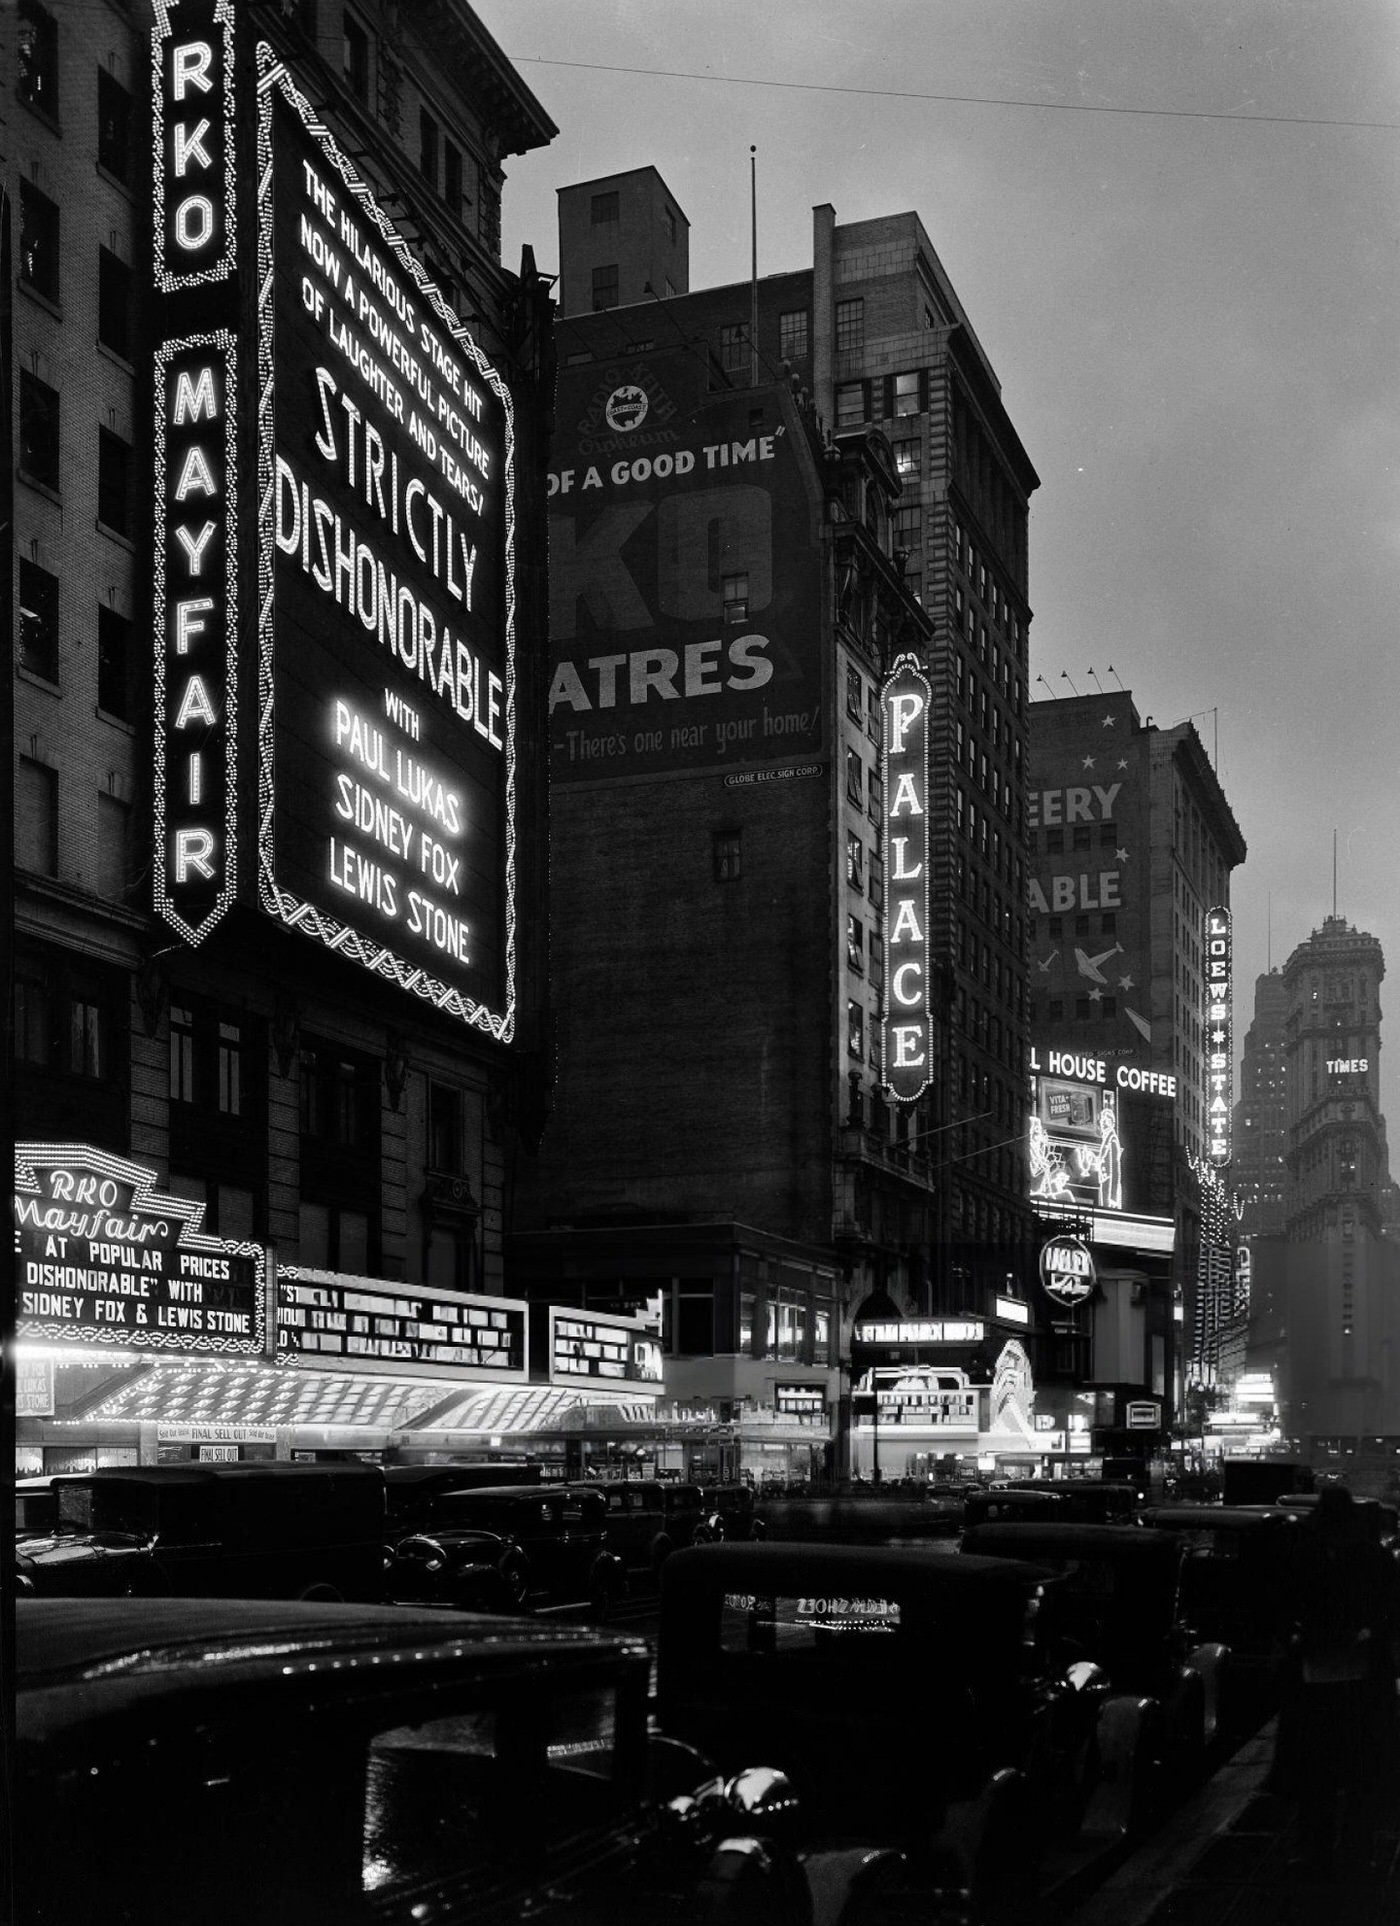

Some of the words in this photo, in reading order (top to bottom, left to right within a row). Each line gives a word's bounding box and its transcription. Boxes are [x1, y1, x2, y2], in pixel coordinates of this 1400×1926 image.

[173, 40, 214, 250] RKO
[303, 158, 336, 229] THE
[340, 218, 415, 333] HILARIOUS
[420, 323, 461, 397] STAGE
[463, 385, 483, 424] HIT
[301, 213, 340, 288] NOW
[344, 274, 355, 310] A
[359, 291, 434, 417] POWERFUL
[438, 397, 490, 480] PICTURE
[301, 276, 325, 323] OF
[328, 308, 404, 424] LAUGHTER
[408, 410, 437, 461] AND
[440, 445, 484, 517] TEARS!
[315, 366, 477, 612] STRICTLY
[548, 470, 575, 496] OF
[582, 466, 603, 490] A
[611, 450, 695, 485] GOOD
[172, 367, 218, 884] MAYFAIR
[275, 452, 503, 751] DISHONORABLE
[548, 634, 774, 714] ATRES
[384, 687, 420, 742] WITH
[634, 725, 663, 748] one
[670, 722, 708, 745] near
[716, 717, 756, 754] your
[763, 706, 820, 737] home!
[335, 699, 390, 783] PAUL
[396, 748, 460, 835] LUKAS
[728, 773, 754, 785] GLOBE
[776, 768, 797, 779] SIGN
[335, 773, 413, 861] SIDNEY
[420, 833, 460, 896] FOX
[329, 835, 398, 918] LEWIS
[405, 889, 470, 965] STONE
[888, 692, 925, 1068] PALACE
[1029, 871, 1121, 913] ABLE
[1030, 1047, 1041, 1070] L
[1049, 1051, 1106, 1083] HOUSE
[1116, 1065, 1177, 1097] COFFEE
[1326, 1058, 1369, 1074] TIMES
[1209, 1052, 1228, 1156] STATE
[15, 1195, 169, 1242] Mayfair
[50, 1170, 118, 1206] RKO
[45, 1235, 68, 1258] AT
[89, 1241, 163, 1271] POPULAR
[180, 1254, 230, 1280] PRICES
[22, 1291, 84, 1318] SIDNEY
[95, 1300, 125, 1322] FOX
[136, 1304, 148, 1324] &
[158, 1306, 202, 1329] LEWIS
[207, 1311, 250, 1333] STONE
[168, 1280, 203, 1303] WITH
[191, 1428, 212, 1440] FINAL
[214, 1428, 232, 1440] SELL
